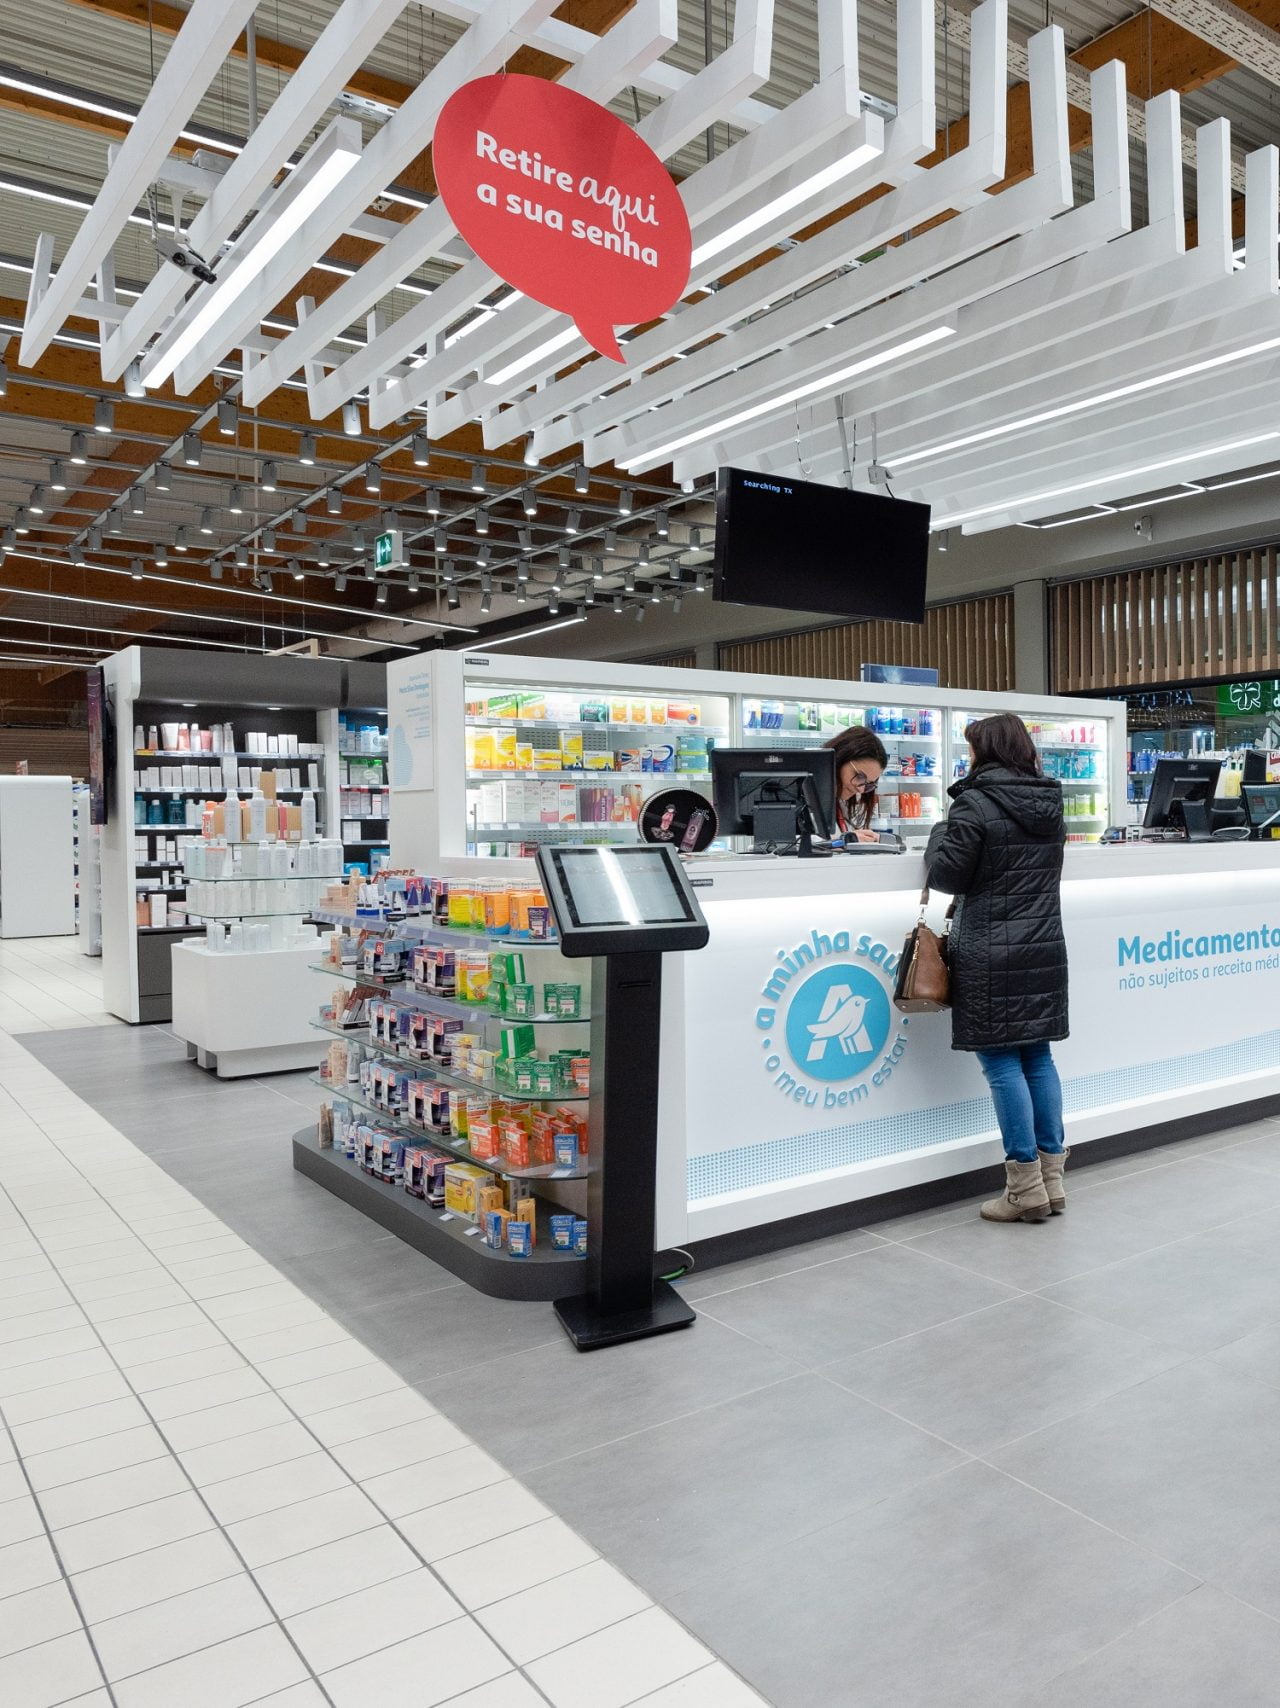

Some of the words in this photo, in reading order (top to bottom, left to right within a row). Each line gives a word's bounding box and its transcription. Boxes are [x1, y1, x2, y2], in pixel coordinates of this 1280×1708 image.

[476, 130, 573, 193] Retire
[579, 176, 659, 232] aqui
[476, 183, 497, 206] a
[506, 193, 563, 231] sua
[571, 218, 658, 267] senha
[784, 486, 793, 494] TX
[762, 930, 850, 1001] minha
[857, 934, 902, 987] saú
[1119, 973, 1145, 990] não
[1149, 967, 1199, 988] sujeitos
[1202, 966, 1209, 978] a
[1213, 959, 1252, 977] receita
[756, 1008, 776, 1029] a
[765, 1055, 780, 1072] o
[775, 1071, 818, 1107] meu
[824, 1083, 868, 1109] bem
[872, 1033, 908, 1086] estar
